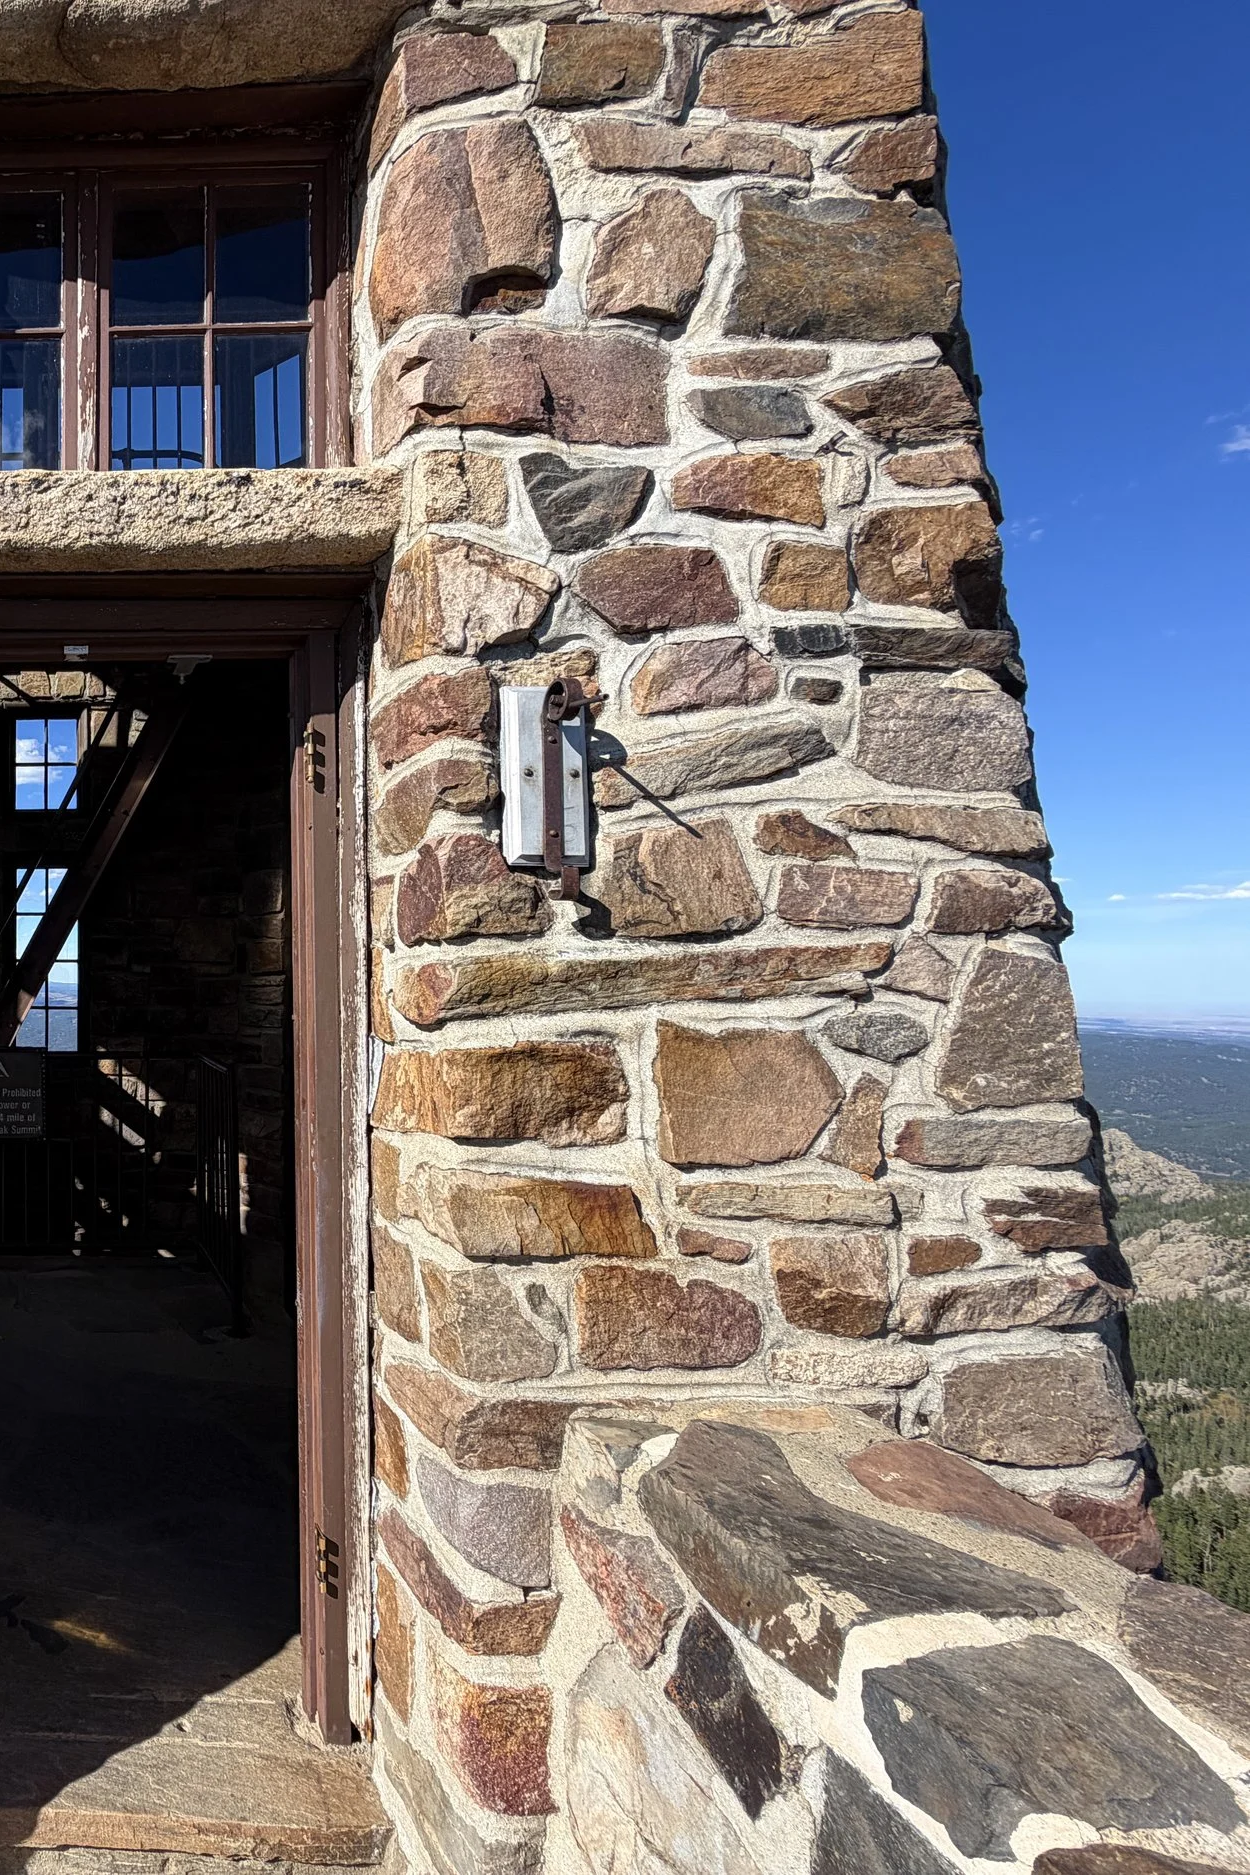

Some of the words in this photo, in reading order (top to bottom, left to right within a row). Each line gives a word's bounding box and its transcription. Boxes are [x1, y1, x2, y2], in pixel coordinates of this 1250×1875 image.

[2, 1088, 41, 1097] Prohibited
[7, 1113, 24, 1122] mile
[27, 1113, 36, 1121] of
